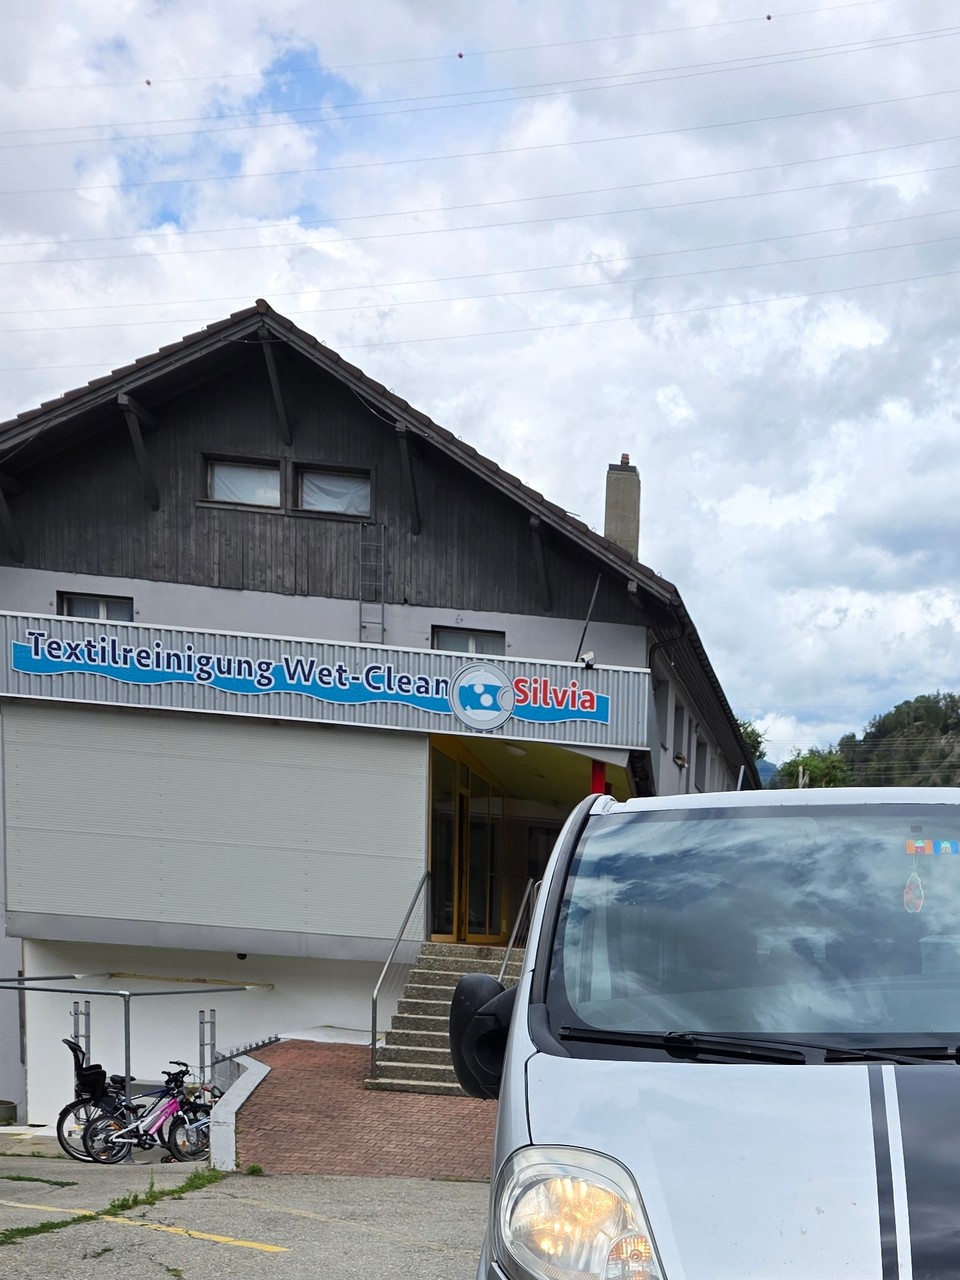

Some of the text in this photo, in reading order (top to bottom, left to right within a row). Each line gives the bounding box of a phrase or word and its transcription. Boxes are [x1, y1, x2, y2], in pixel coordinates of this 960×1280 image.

[26, 630, 596, 711] Textilreinigung Wet-Clean Silvia
